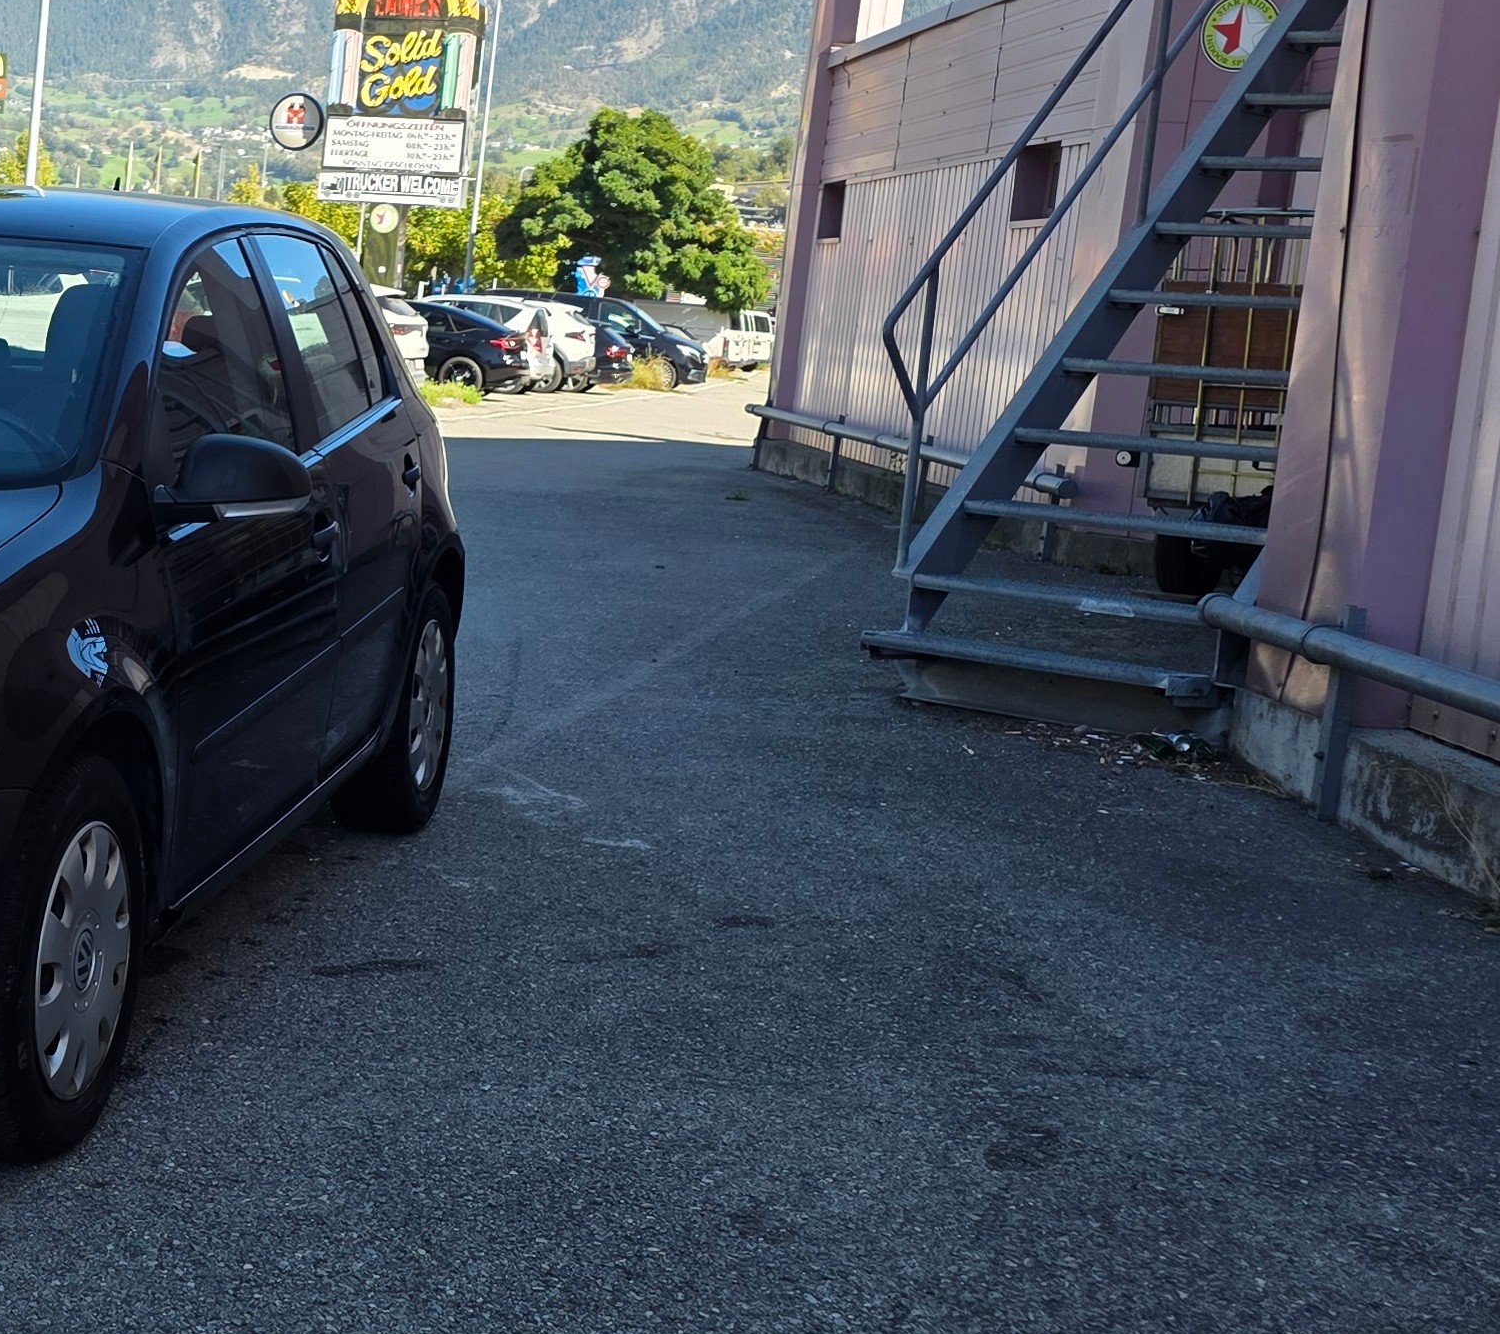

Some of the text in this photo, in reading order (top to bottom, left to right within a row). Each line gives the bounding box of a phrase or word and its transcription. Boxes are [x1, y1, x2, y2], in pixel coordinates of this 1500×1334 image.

[361, 29, 442, 73] Solid
[1206, 34, 1229, 65] INDOOR
[361, 65, 437, 107] Gold
[346, 173, 459, 196] TRUCKER WELCOME
